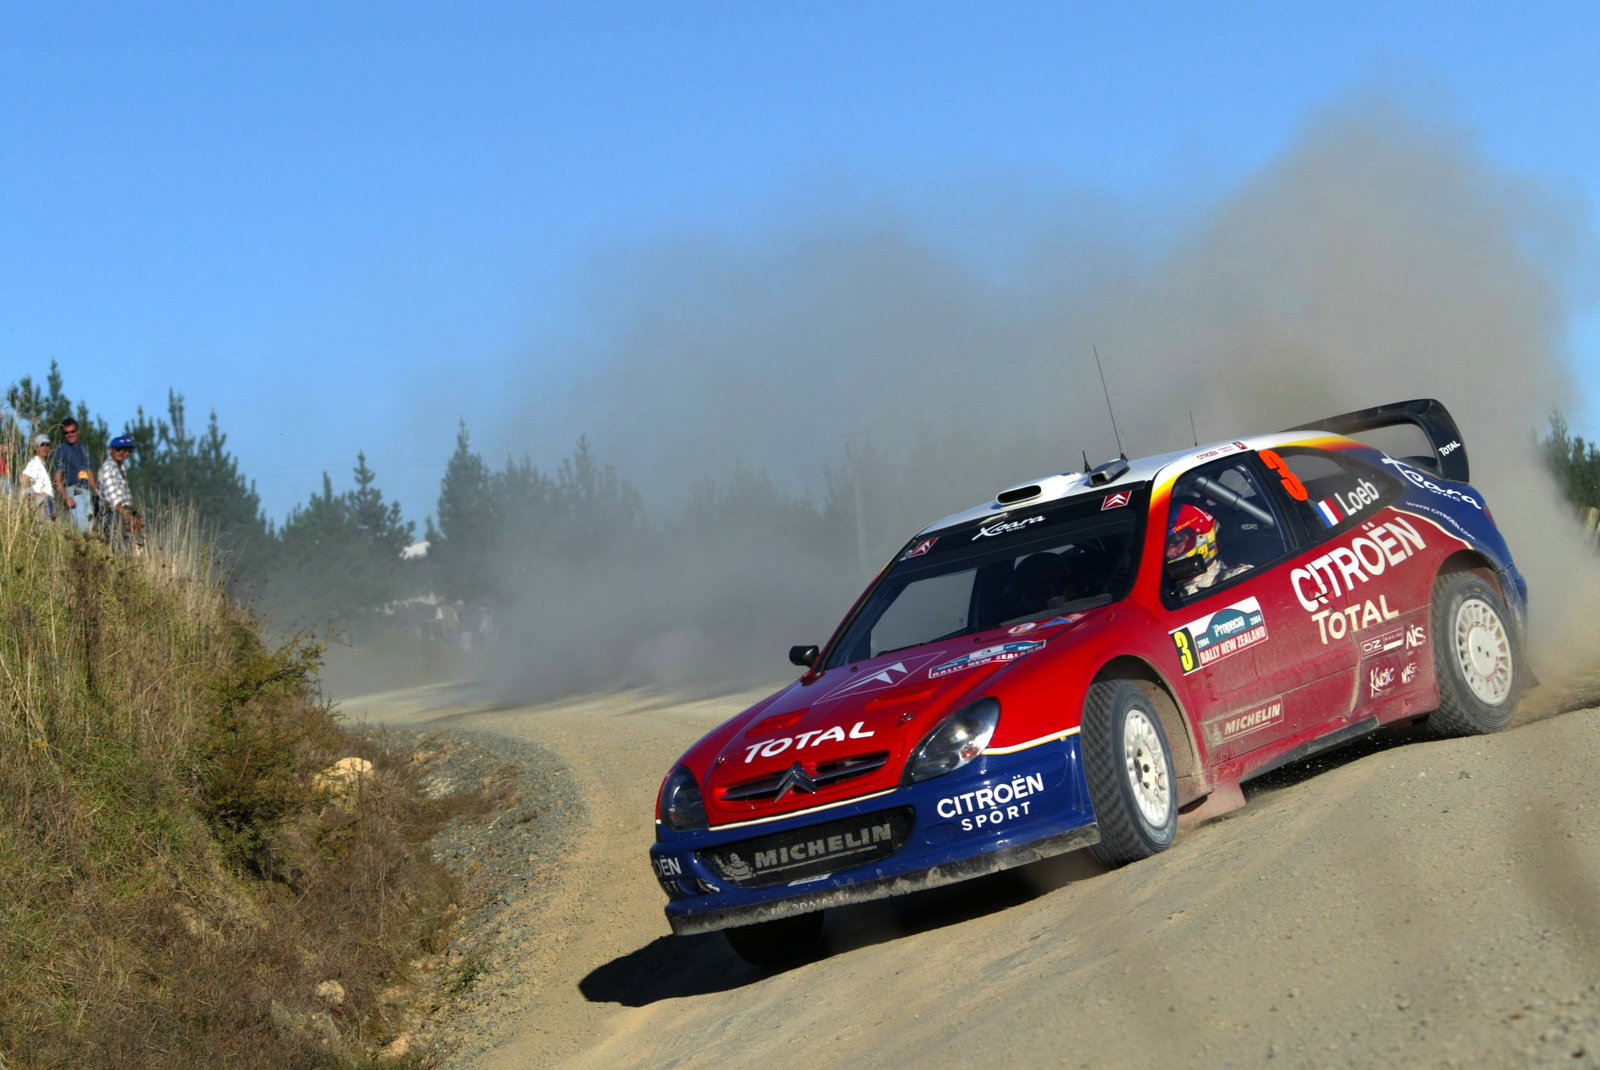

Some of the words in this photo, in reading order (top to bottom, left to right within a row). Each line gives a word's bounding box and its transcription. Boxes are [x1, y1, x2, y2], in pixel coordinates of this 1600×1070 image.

[1439, 441, 1461, 456] TOTAL
[1258, 449, 1308, 501] 3
[1381, 451, 1482, 510] Xsara
[1335, 478, 1380, 517] Loeb
[971, 515, 1046, 541] Xsara
[1290, 516, 1427, 612] CITROËN
[1213, 615, 1245, 637] Propecia
[1311, 594, 1400, 644] TOTAL
[968, 657, 992, 667] NEW
[1174, 631, 1194, 672] 3
[1200, 645, 1220, 665] RALLY
[1220, 638, 1238, 656] NEW
[1236, 626, 1266, 648] ZEALAND
[1363, 639, 1382, 652] OZ
[1224, 703, 1281, 735] MICHELIN
[744, 721, 875, 764] TOTAL
[936, 772, 1045, 819] CITROËN
[961, 801, 1031, 831] SPORT
[754, 823, 892, 868] MICHELIN
